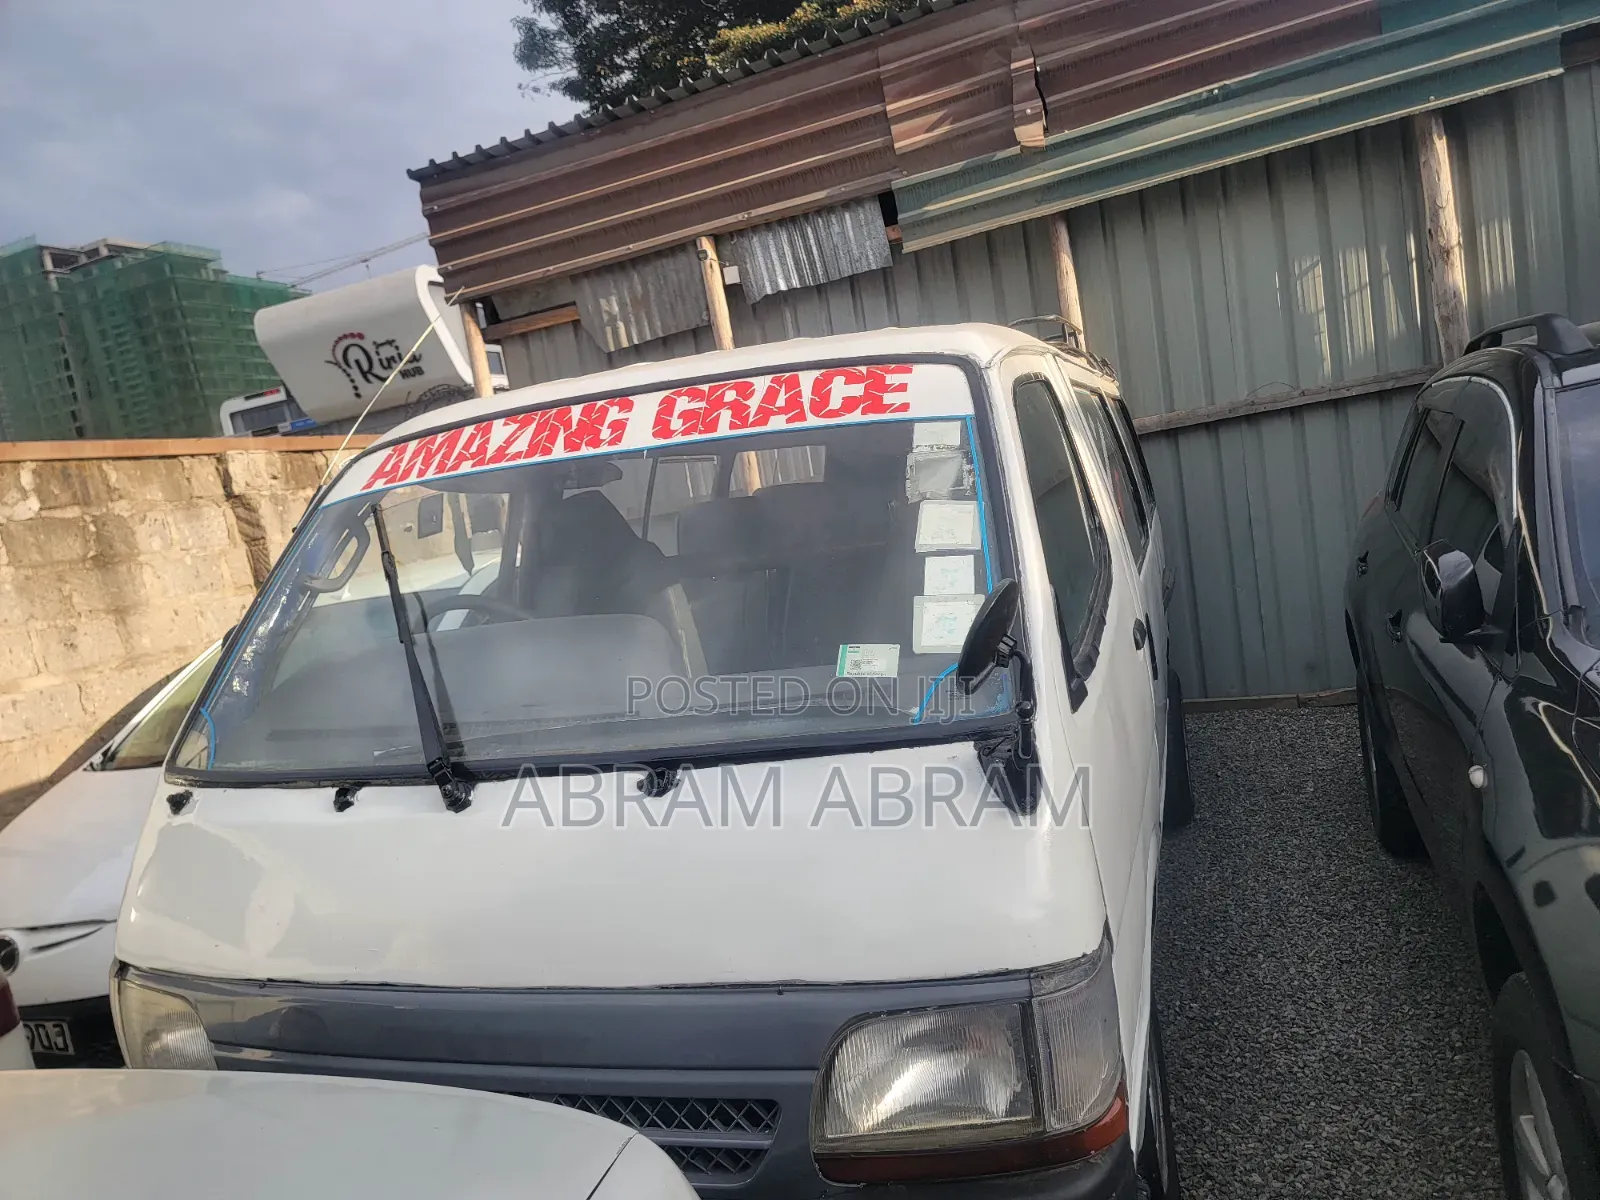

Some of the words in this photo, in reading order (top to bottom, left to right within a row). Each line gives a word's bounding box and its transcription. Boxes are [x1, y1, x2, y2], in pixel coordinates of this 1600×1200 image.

[400, 366, 424, 380] HUB
[360, 396, 635, 491] AMAZING
[651, 364, 913, 440] GRACE
